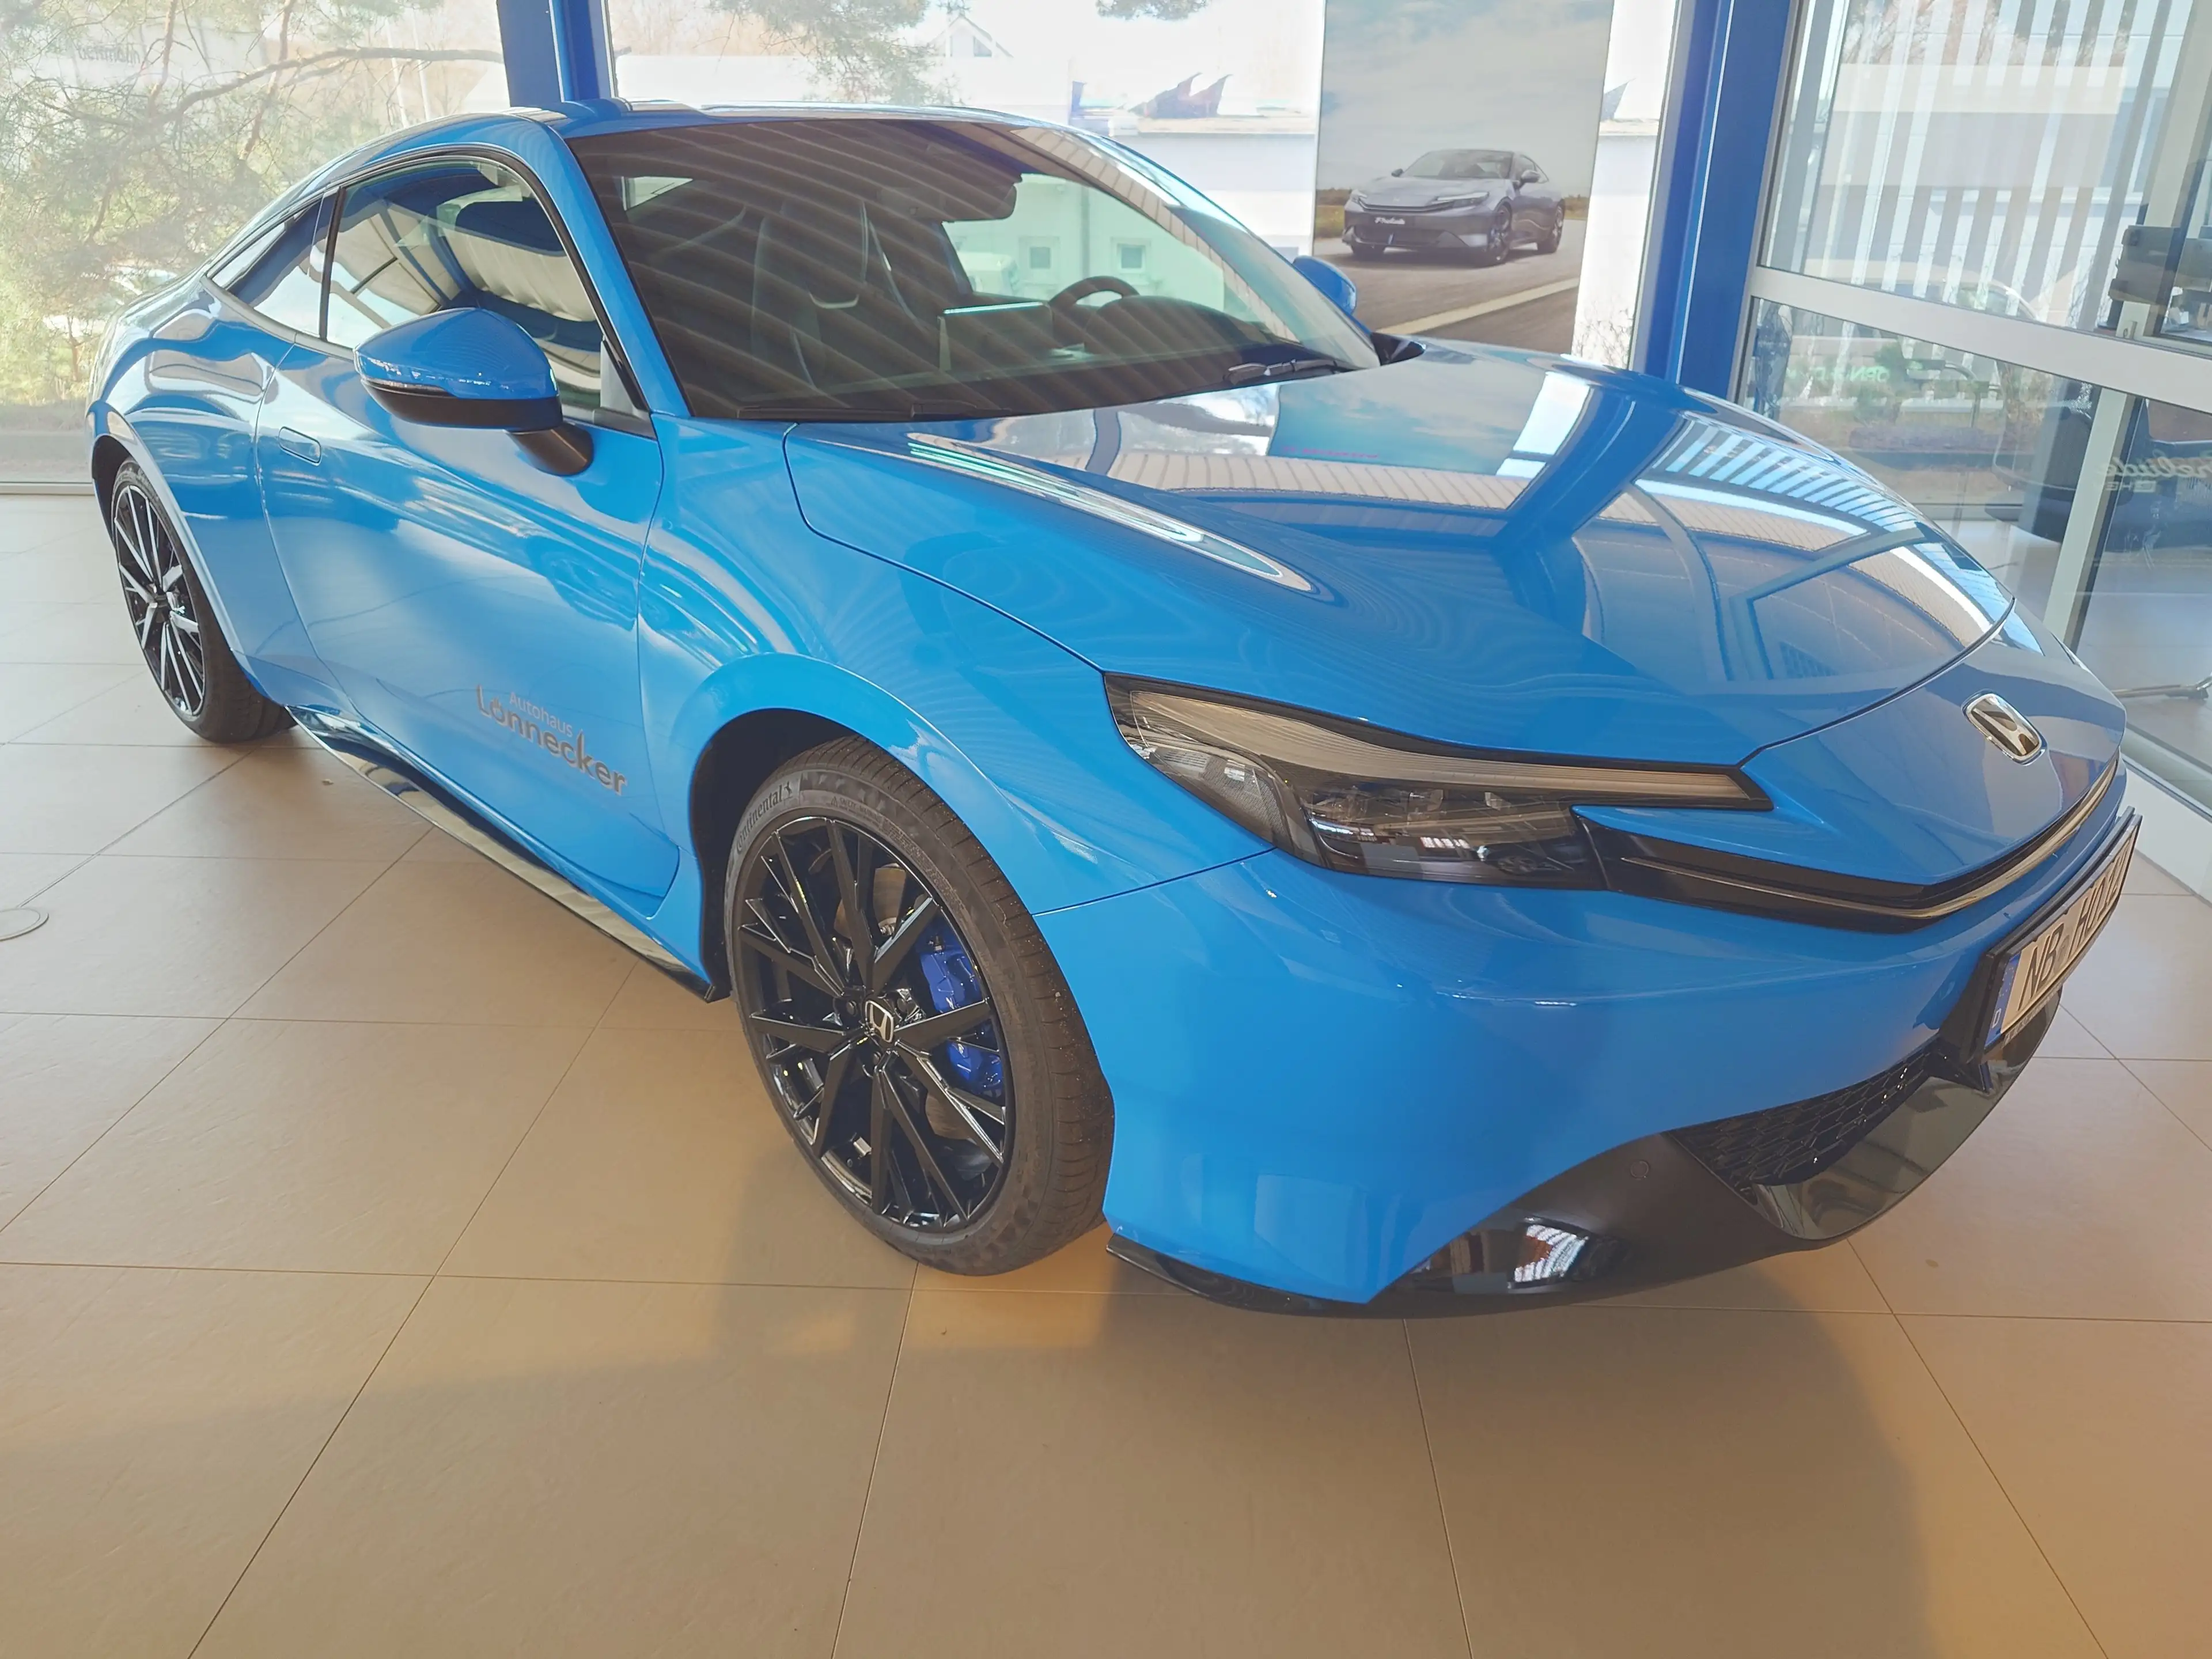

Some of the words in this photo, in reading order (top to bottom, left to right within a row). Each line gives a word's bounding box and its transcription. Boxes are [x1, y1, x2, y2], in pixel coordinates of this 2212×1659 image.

[509, 691, 573, 737] Autohaus
[736, 784, 783, 855] Continental
[2017, 922, 2065, 1012] NB
